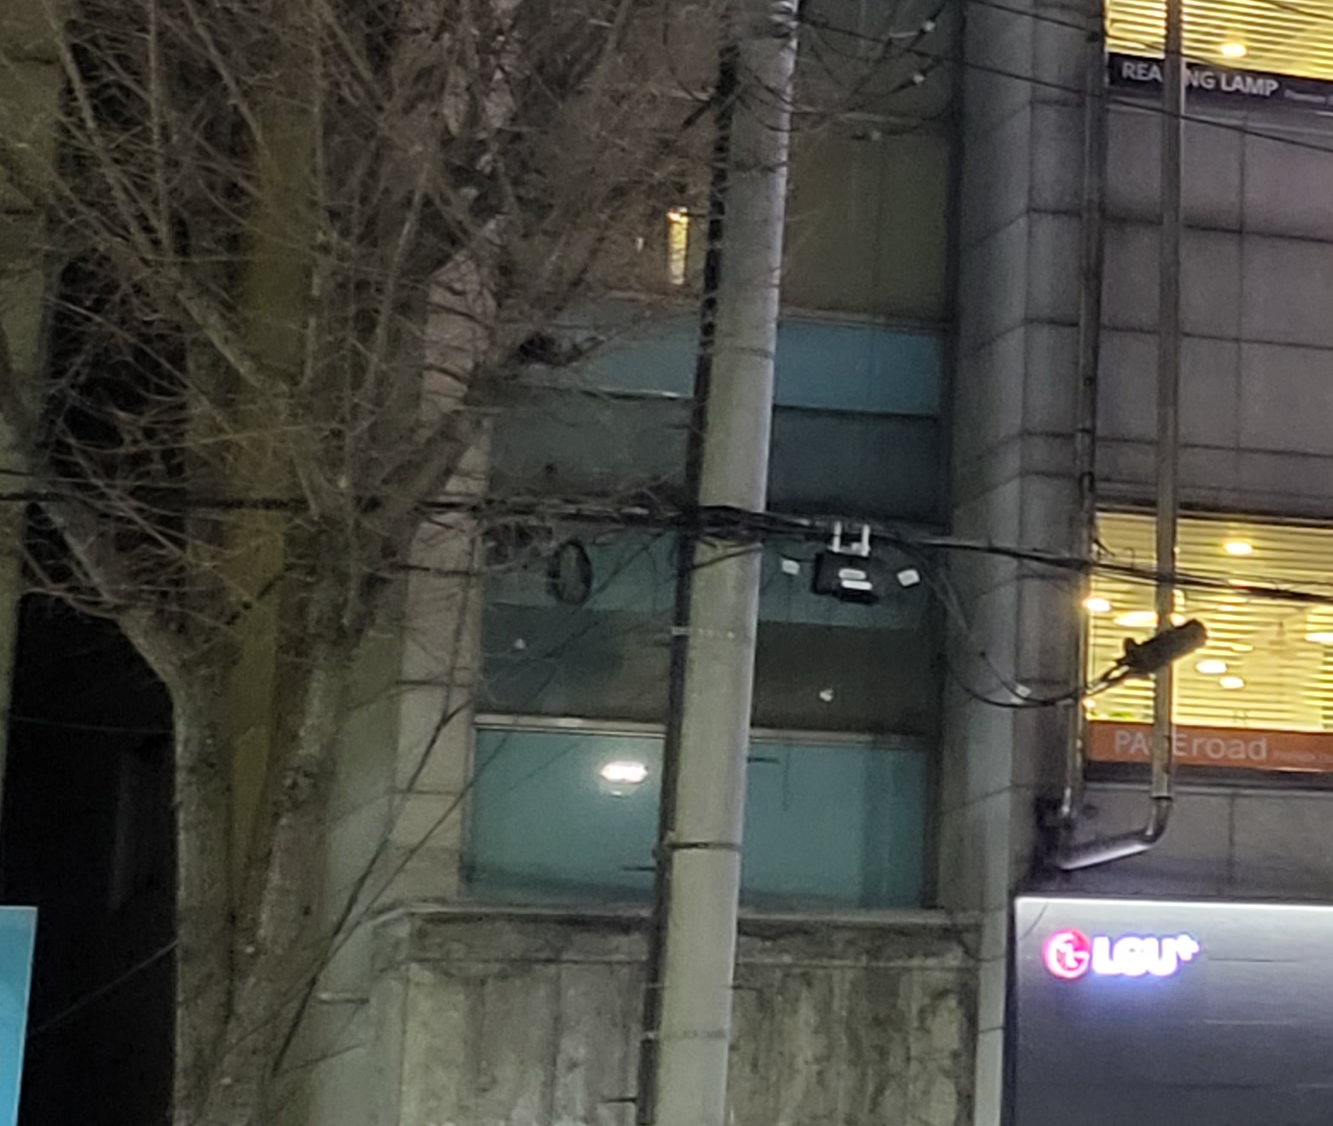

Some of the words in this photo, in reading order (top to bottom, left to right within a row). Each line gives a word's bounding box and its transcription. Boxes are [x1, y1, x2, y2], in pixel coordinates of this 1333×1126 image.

[1121, 60, 1215, 90] REANG
[1219, 74, 1280, 98] LAMP
[1113, 728, 1268, 761] PAEroad
